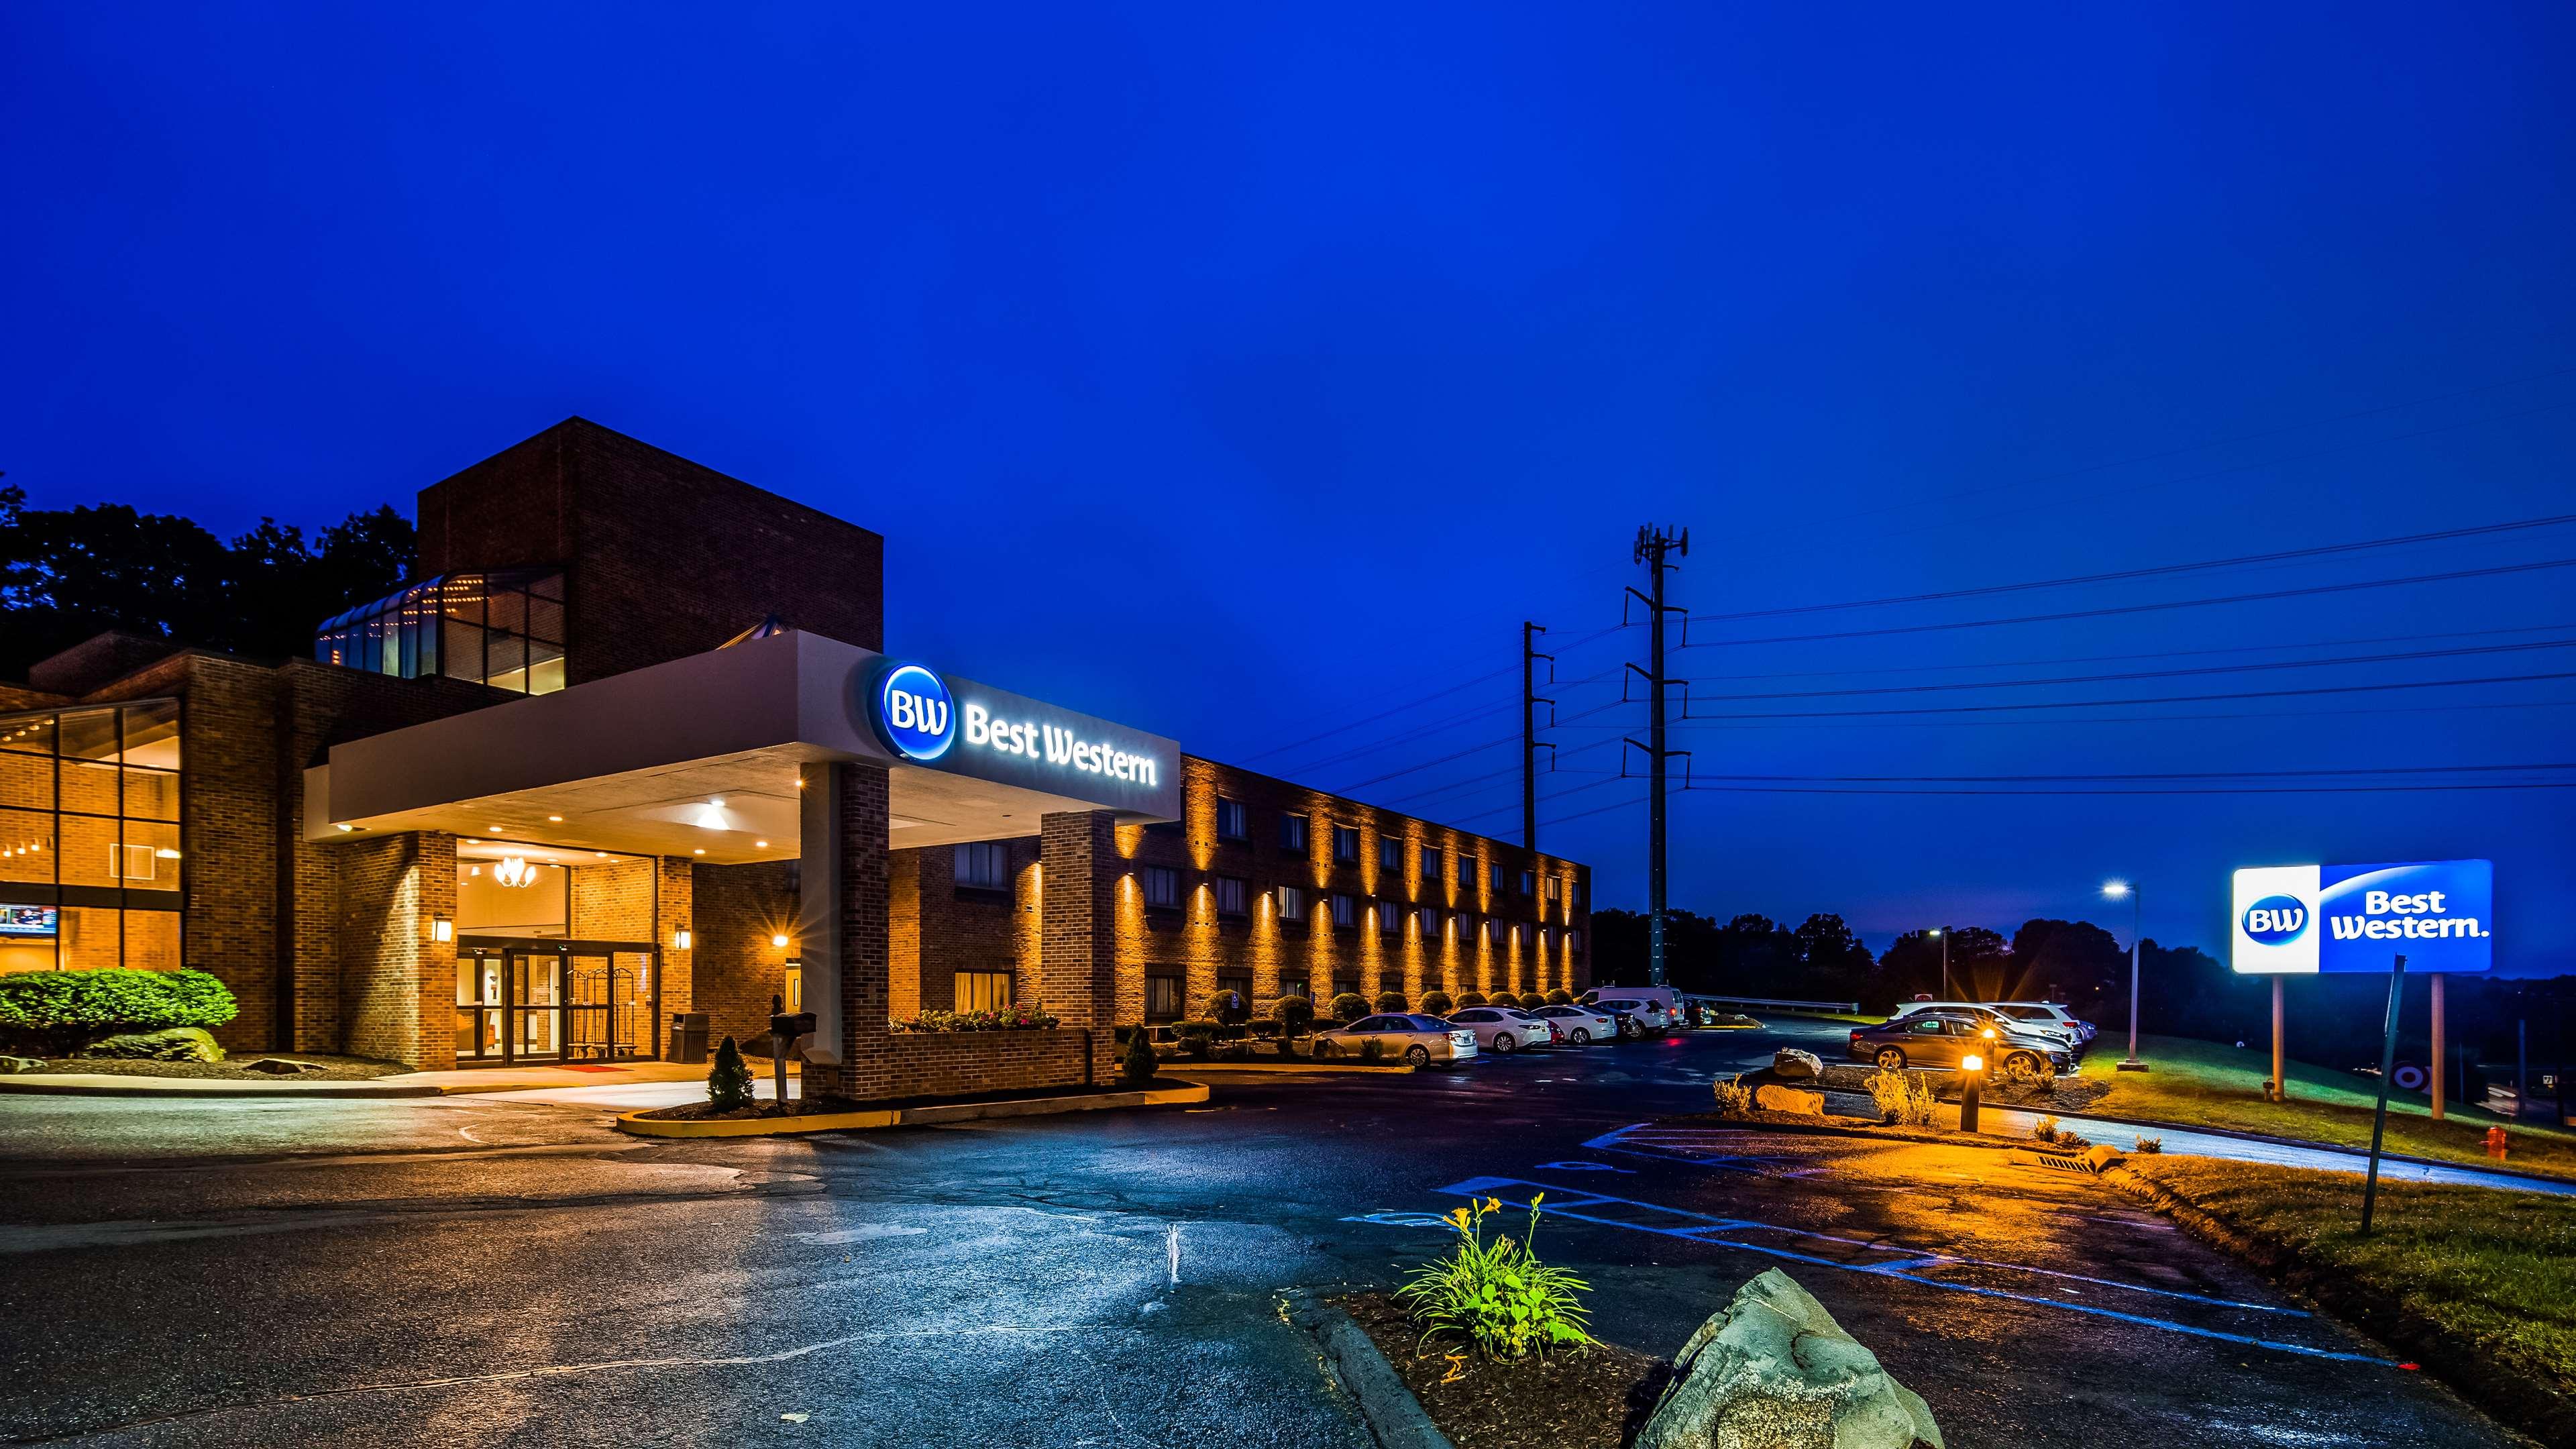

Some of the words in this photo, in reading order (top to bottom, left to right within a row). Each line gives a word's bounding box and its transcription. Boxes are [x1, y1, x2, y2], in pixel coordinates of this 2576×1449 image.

[892, 690, 947, 736] BW
[966, 704, 1040, 758] Best
[1043, 725, 1157, 786] Western
[2249, 908, 2304, 932] BW
[2365, 890, 2446, 915] Best
